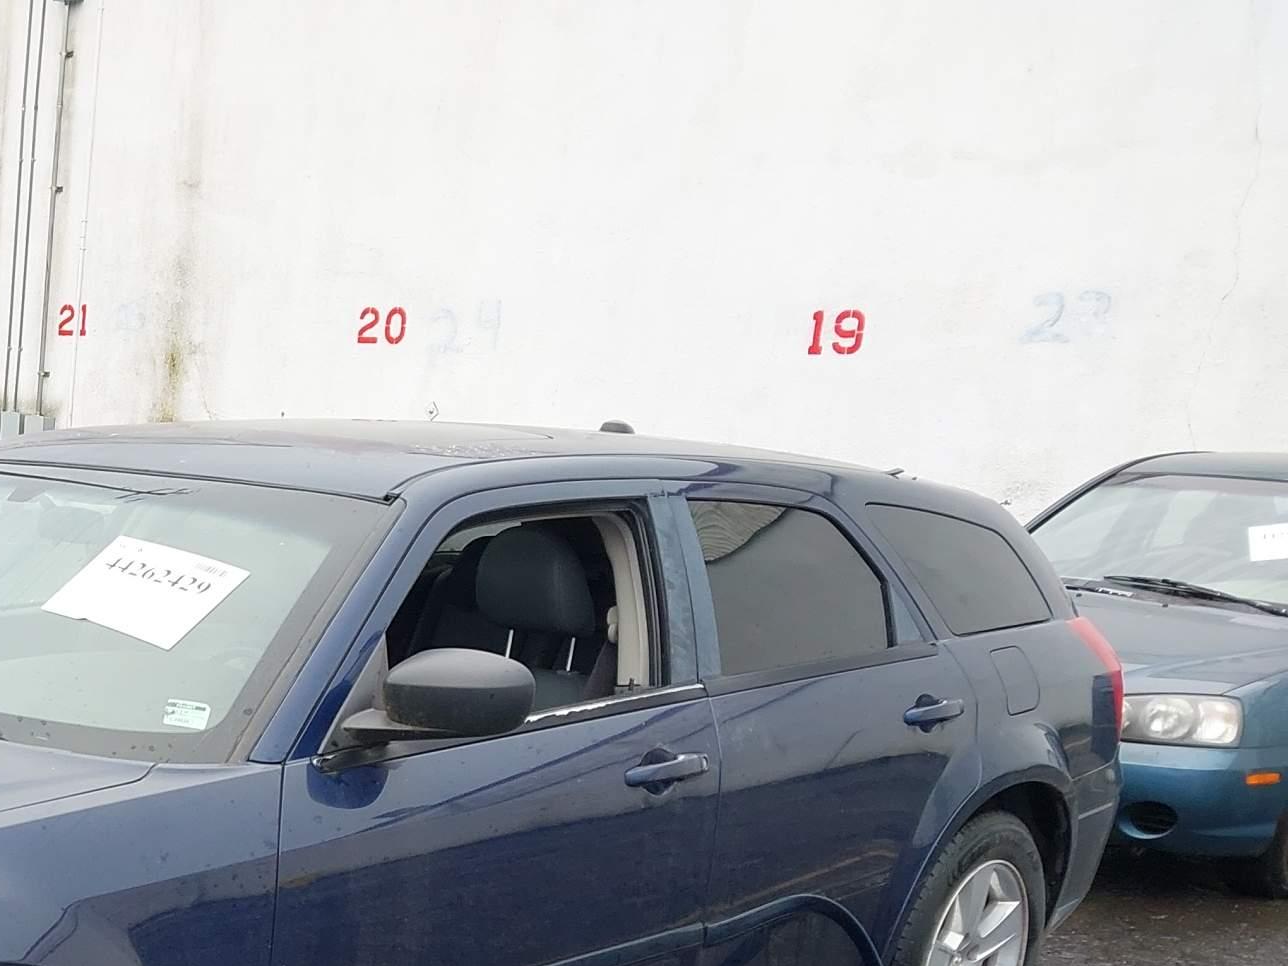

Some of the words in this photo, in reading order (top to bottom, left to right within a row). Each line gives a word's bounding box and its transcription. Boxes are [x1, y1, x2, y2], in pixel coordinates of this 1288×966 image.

[58, 303, 87, 337] 21
[357, 306, 408, 345] 20
[807, 309, 866, 356] 19
